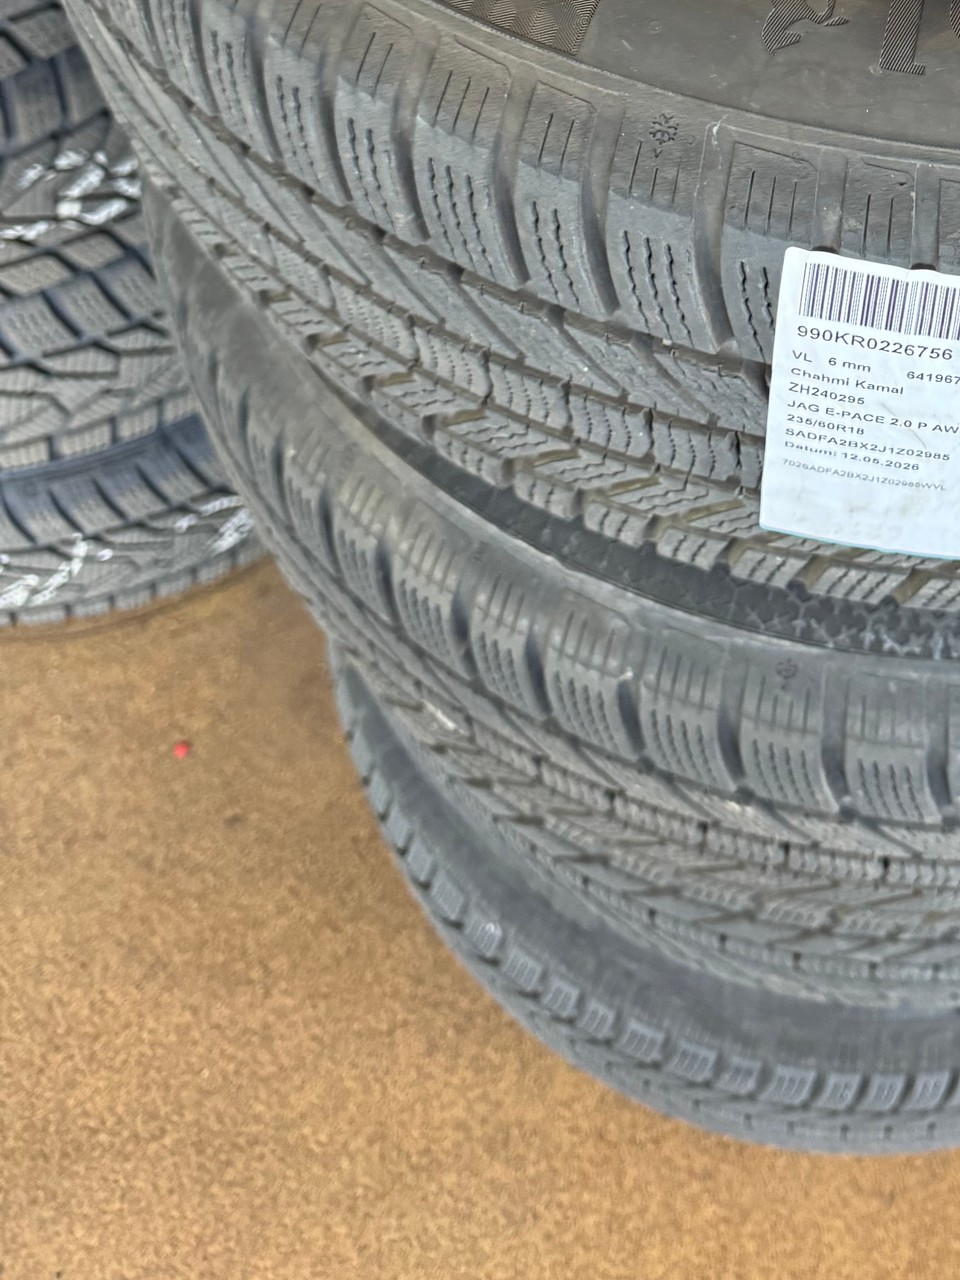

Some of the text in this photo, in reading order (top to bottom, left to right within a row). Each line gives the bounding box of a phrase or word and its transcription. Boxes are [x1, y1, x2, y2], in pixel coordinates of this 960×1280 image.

[797, 325, 953, 361] 990KR0226756
[792, 349, 813, 363] VL
[828, 357, 837, 366] 6
[842, 361, 871, 373] mm
[788, 381, 865, 405] ZH240295
[790, 367, 904, 395] Chahmi Kamal
[787, 400, 820, 413] JAG
[825, 407, 885, 424] E-PACE
[890, 417, 912, 428] 2.0
[918, 421, 928, 429] P
[787, 413, 865, 436] 235/60R18
[784, 441, 920, 471] Datum: 12.05.2026
[785, 428, 951, 461] SADFA2BX2J1Z02985
